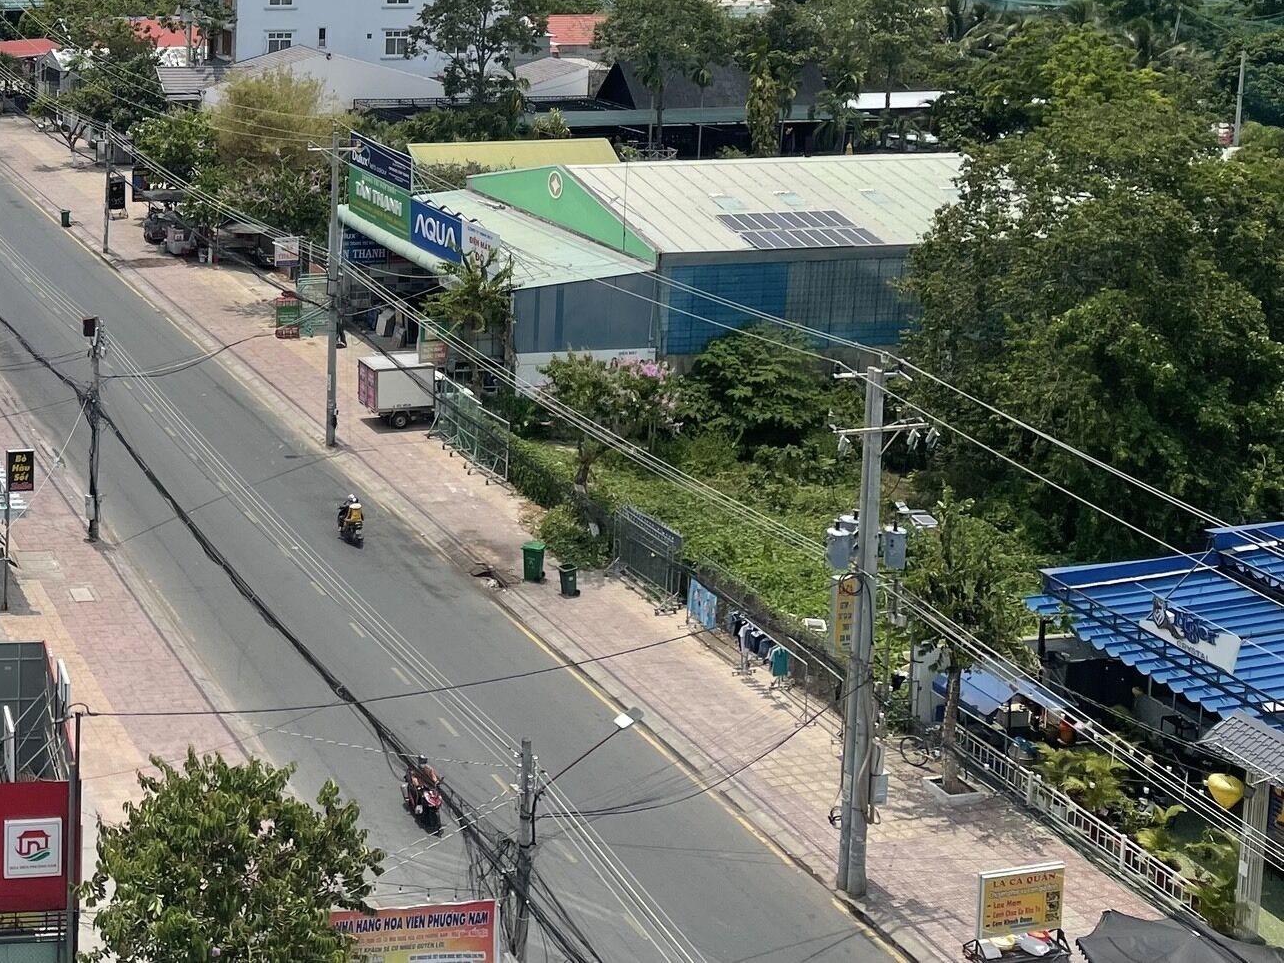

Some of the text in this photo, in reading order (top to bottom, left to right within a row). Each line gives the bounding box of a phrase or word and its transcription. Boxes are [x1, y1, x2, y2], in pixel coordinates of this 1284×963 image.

[414, 213, 457, 253] AQUA
[383, 916, 403, 931] HOA
[468, 911, 489, 925] NAM
